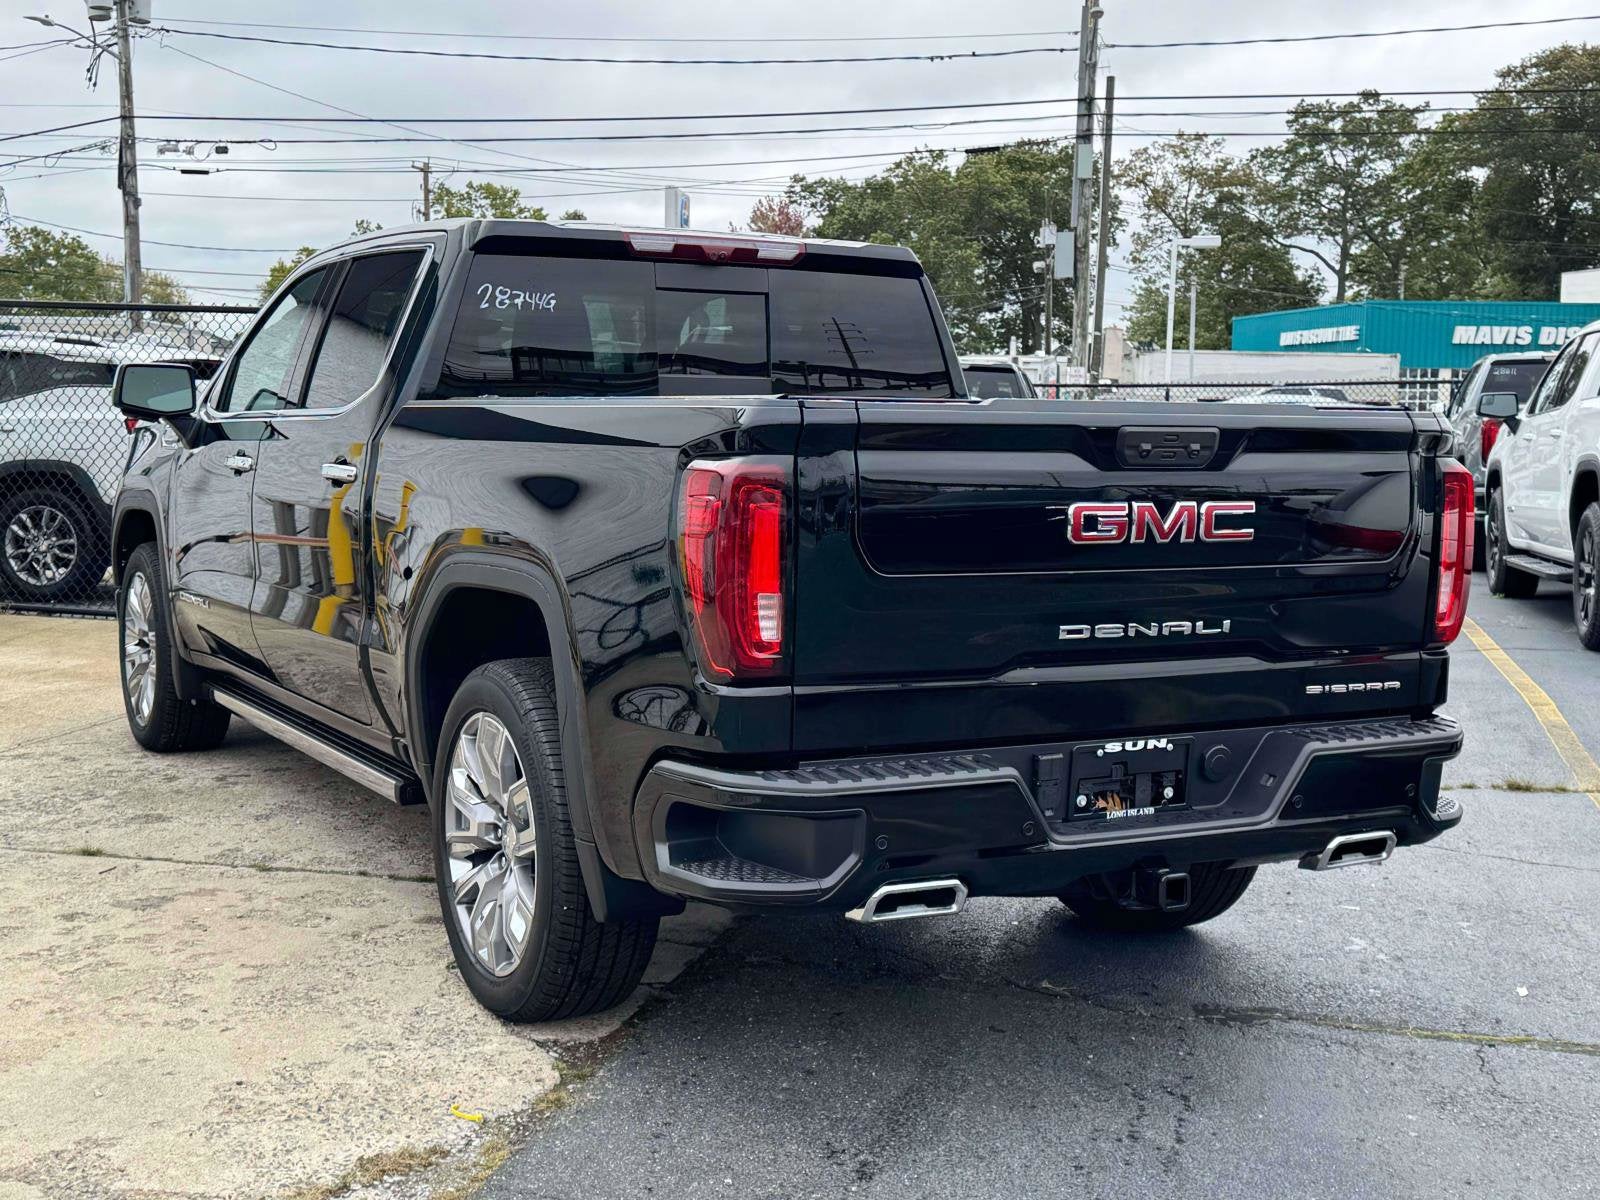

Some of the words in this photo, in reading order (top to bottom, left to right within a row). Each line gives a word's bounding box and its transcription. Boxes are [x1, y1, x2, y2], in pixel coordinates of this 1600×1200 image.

[1452, 325, 1534, 346] MAVIS
[1067, 501, 1256, 544] GMC
[1059, 619, 1231, 640] DENALI
[1305, 681, 1401, 694] SIERRA
[1104, 738, 1168, 753] SUN
[1106, 809, 1127, 819] LONG
[1127, 807, 1155, 816] ISLAND
